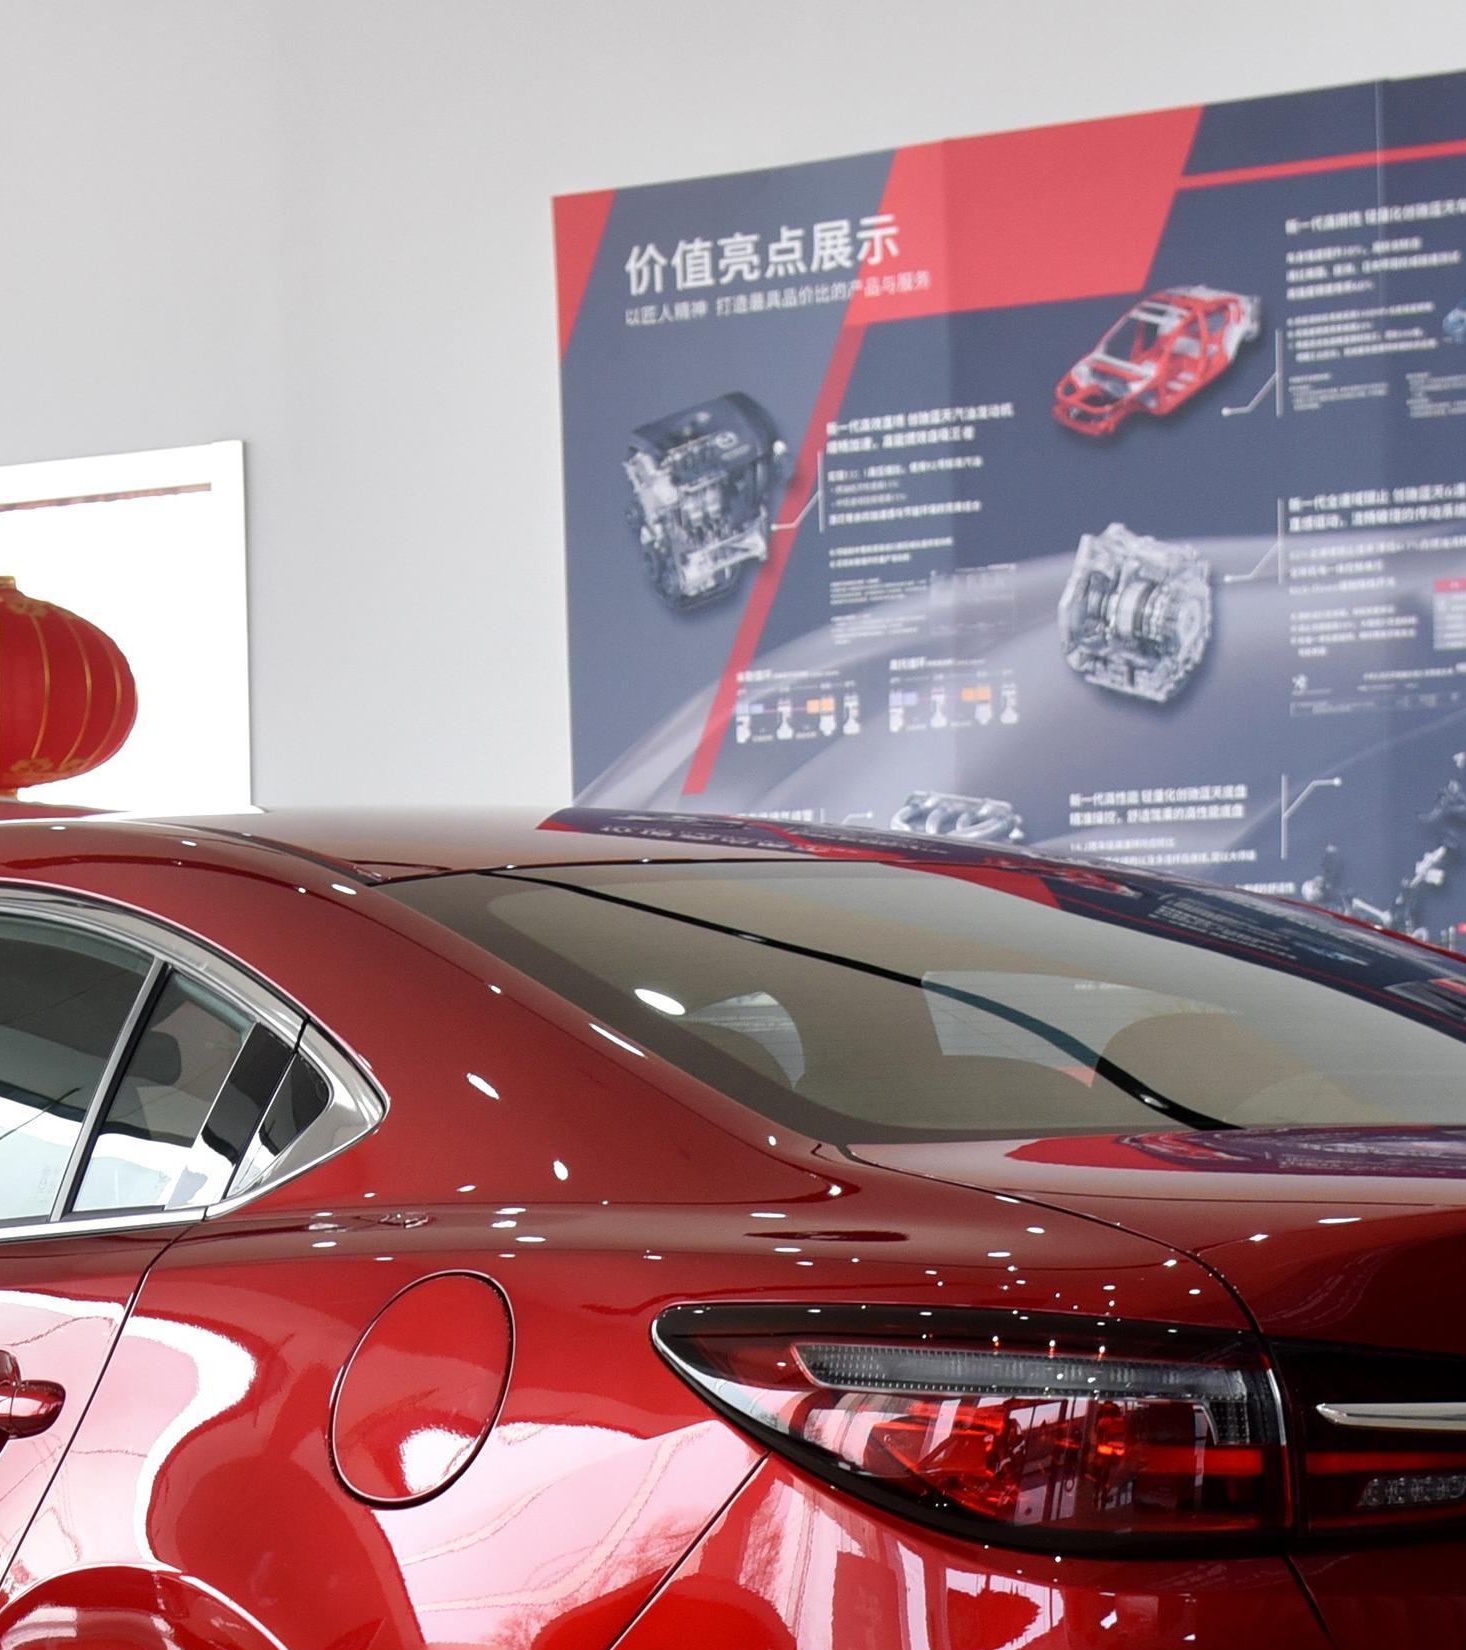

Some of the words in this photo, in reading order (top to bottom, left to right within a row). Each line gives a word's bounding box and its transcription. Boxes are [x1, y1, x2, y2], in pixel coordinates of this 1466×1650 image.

[624, 213, 900, 296] 价值亮点展示
